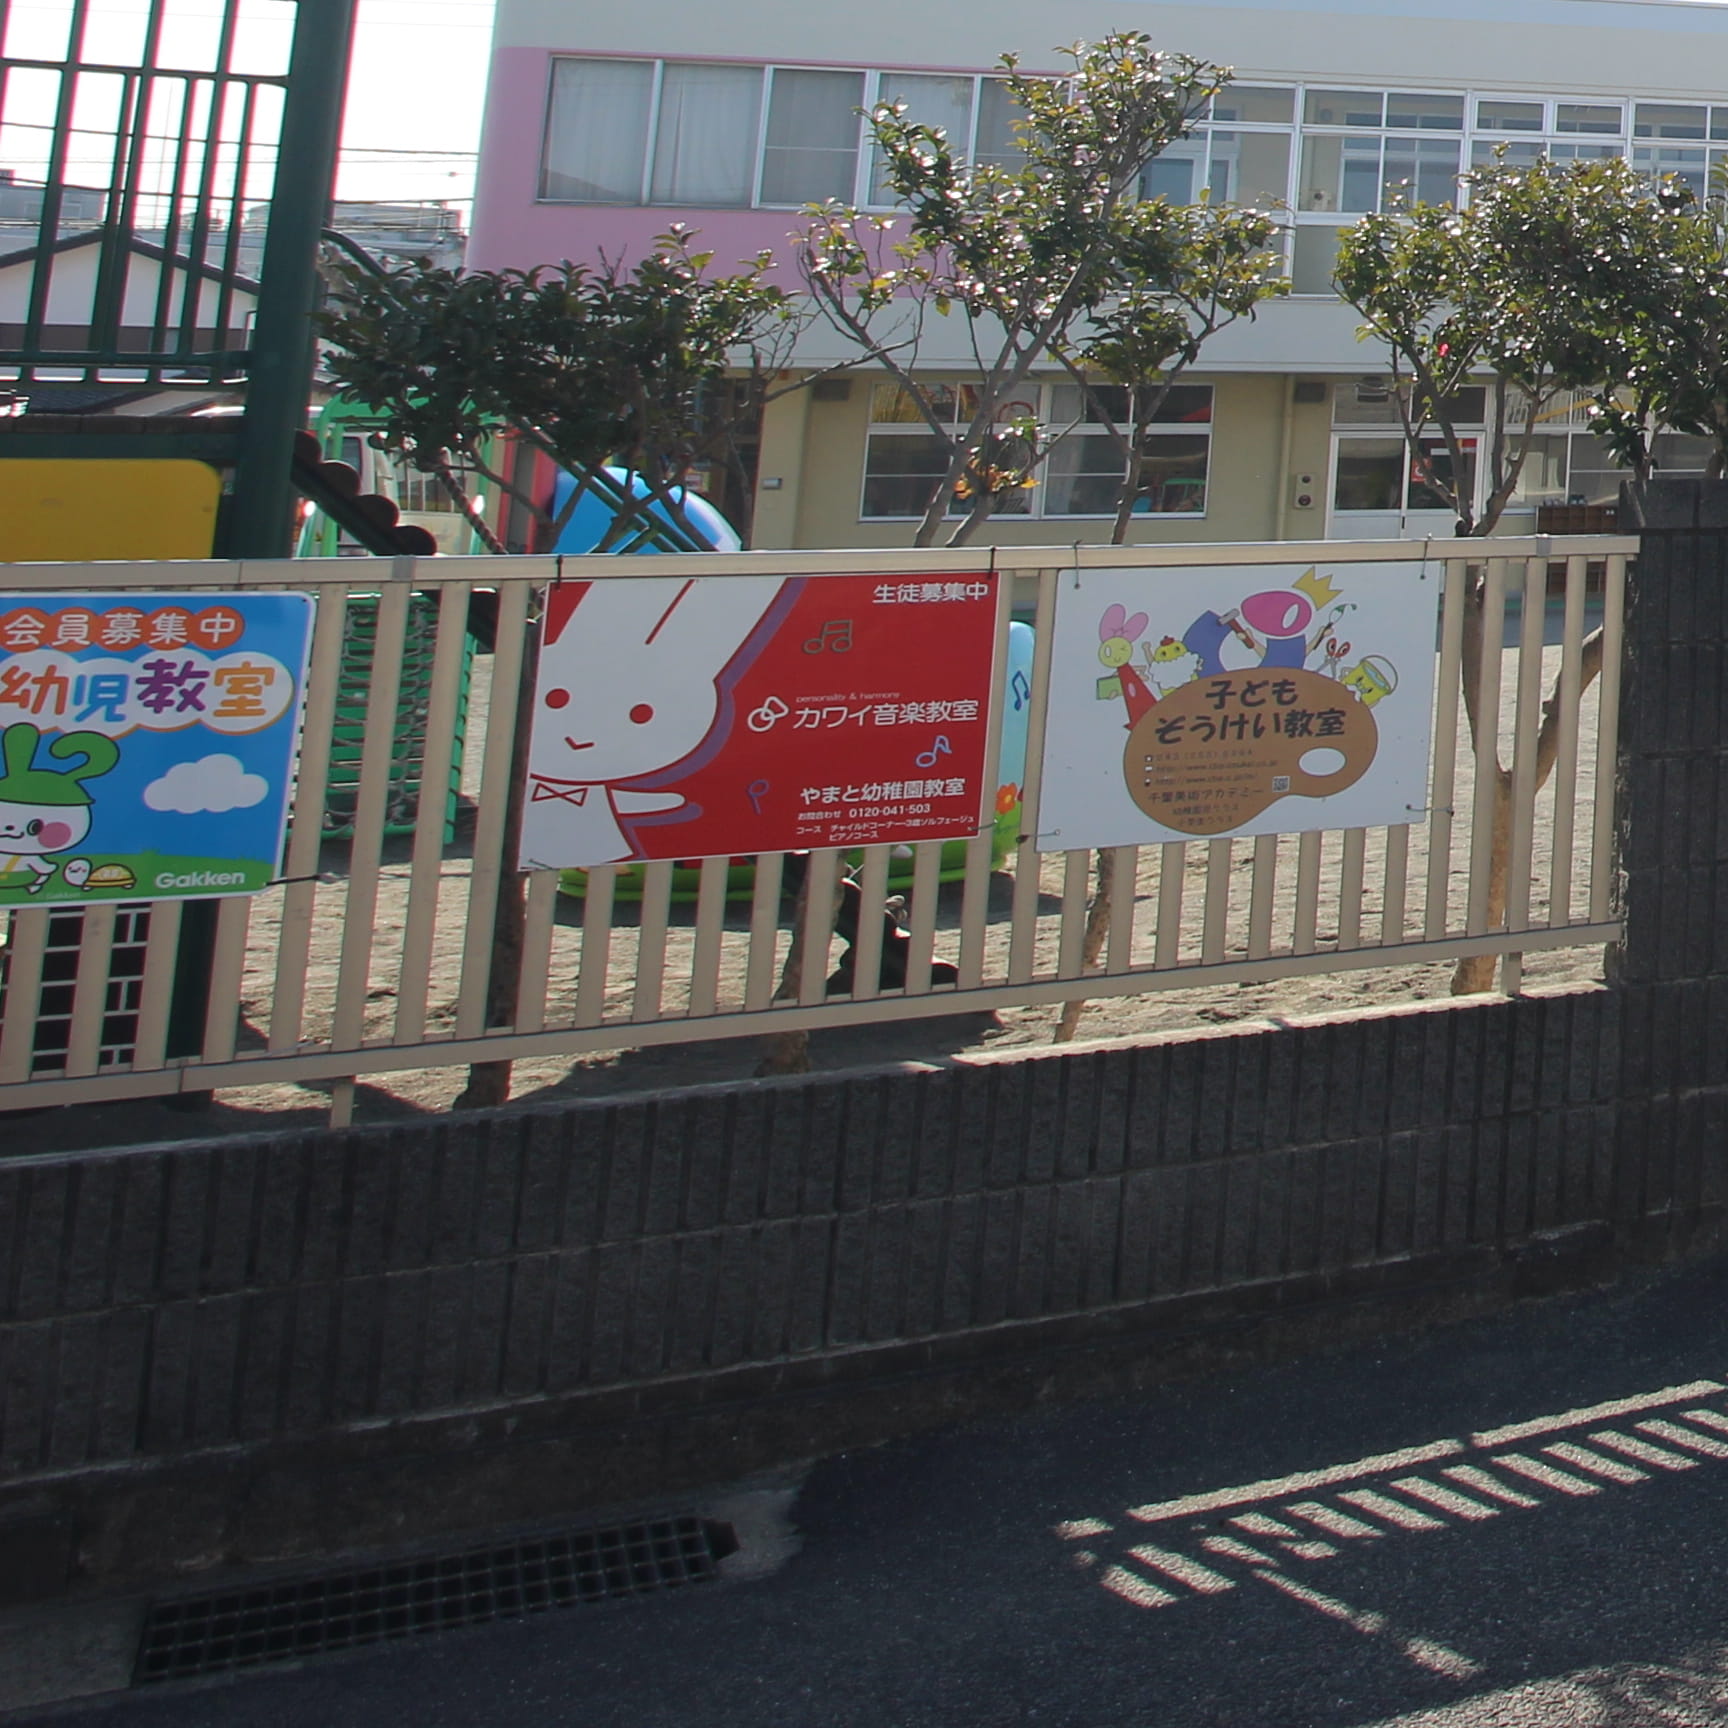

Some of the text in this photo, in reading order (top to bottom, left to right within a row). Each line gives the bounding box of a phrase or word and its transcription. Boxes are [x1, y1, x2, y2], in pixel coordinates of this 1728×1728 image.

[871, 581, 989, 604] 生徒募集中
[3, 612, 237, 647] 会員募集中
[0, 658, 276, 723] 幼児教室
[1205, 679, 1299, 710] 子ども
[792, 699, 979, 729] カワイ音楽教室
[800, 778, 966, 806] やまと幼稚園教室
[797, 803, 931, 821] お問合わせ 0120-041-503
[796, 825, 822, 835] コース
[828, 830, 880, 842] ピアノコース
[154, 871, 246, 889] Gakken
